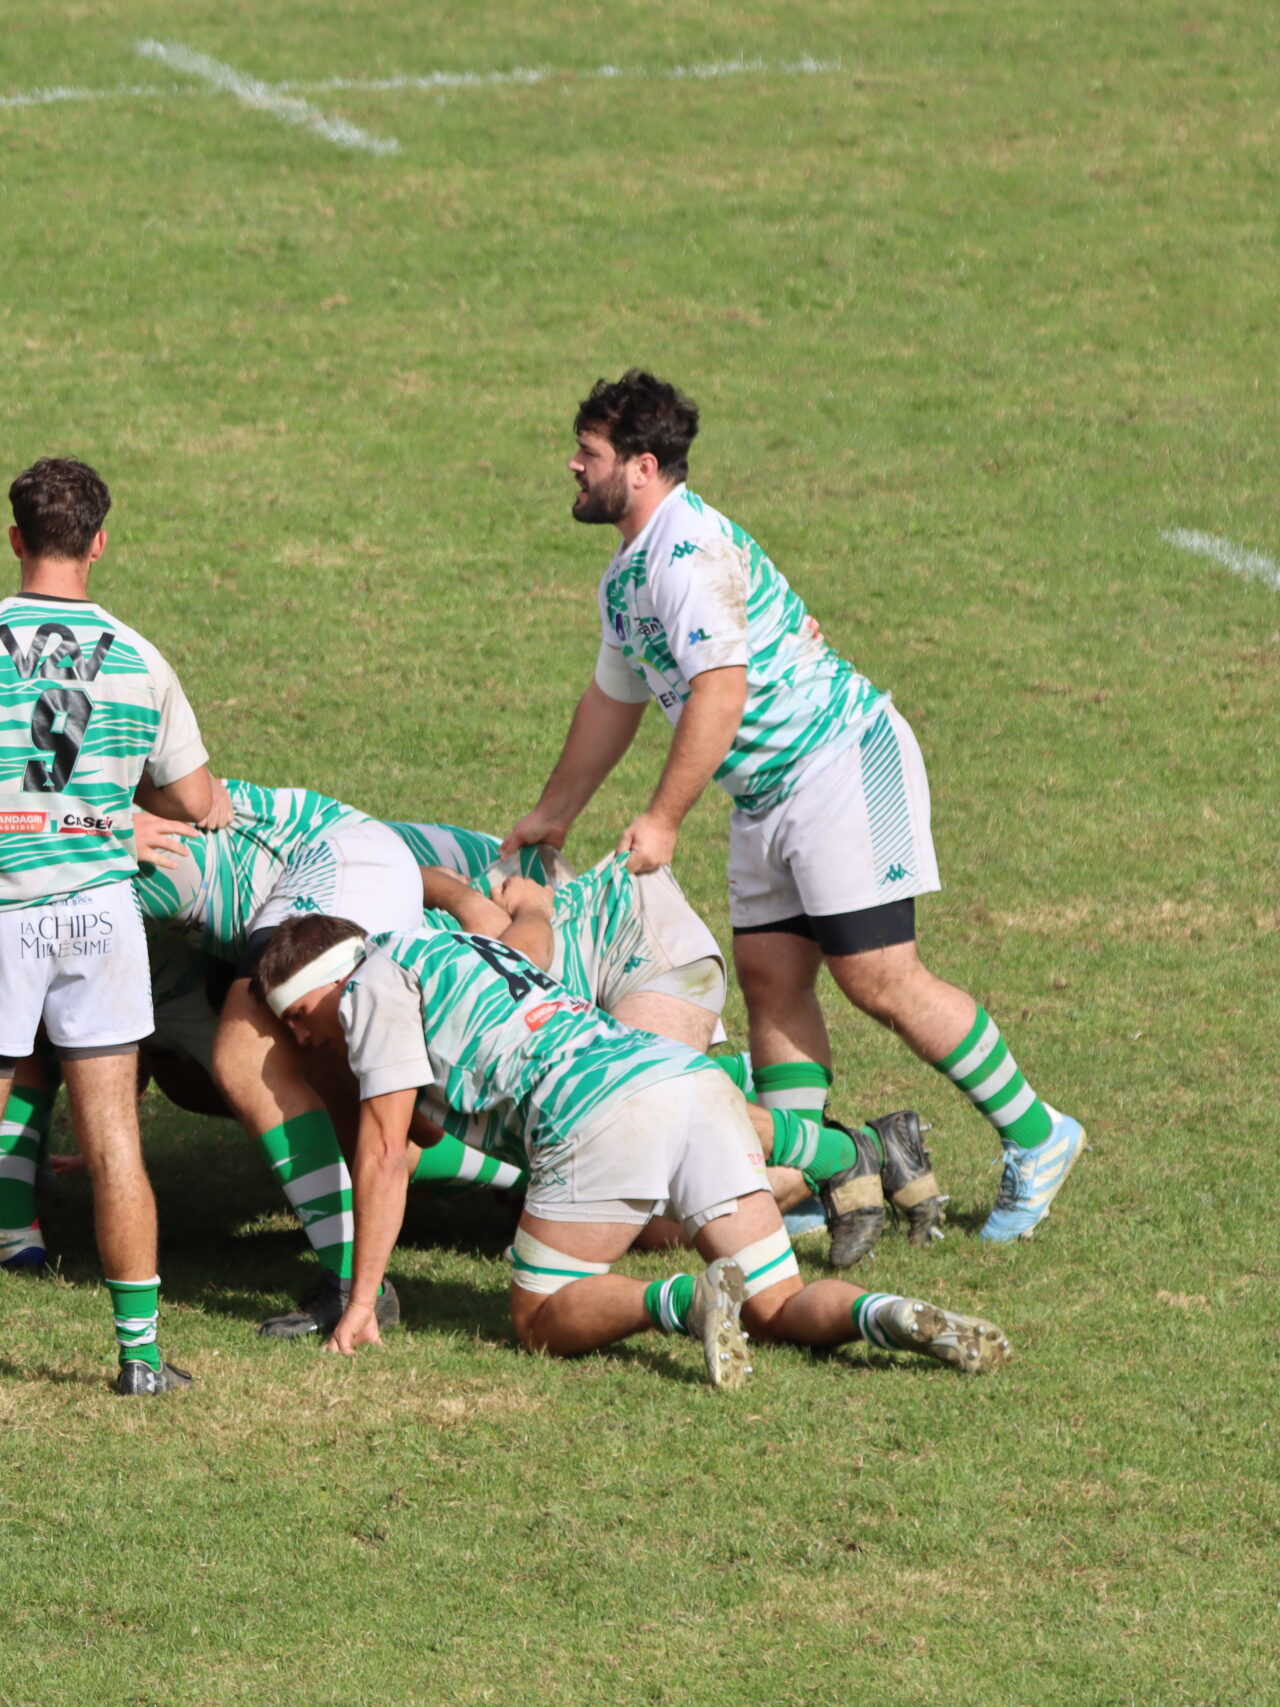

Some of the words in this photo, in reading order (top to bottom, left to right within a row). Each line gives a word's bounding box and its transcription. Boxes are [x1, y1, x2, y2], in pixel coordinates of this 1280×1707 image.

[22, 688, 93, 793] 9
[20, 921, 35, 936] LA
[38, 911, 113, 940] CHIPS
